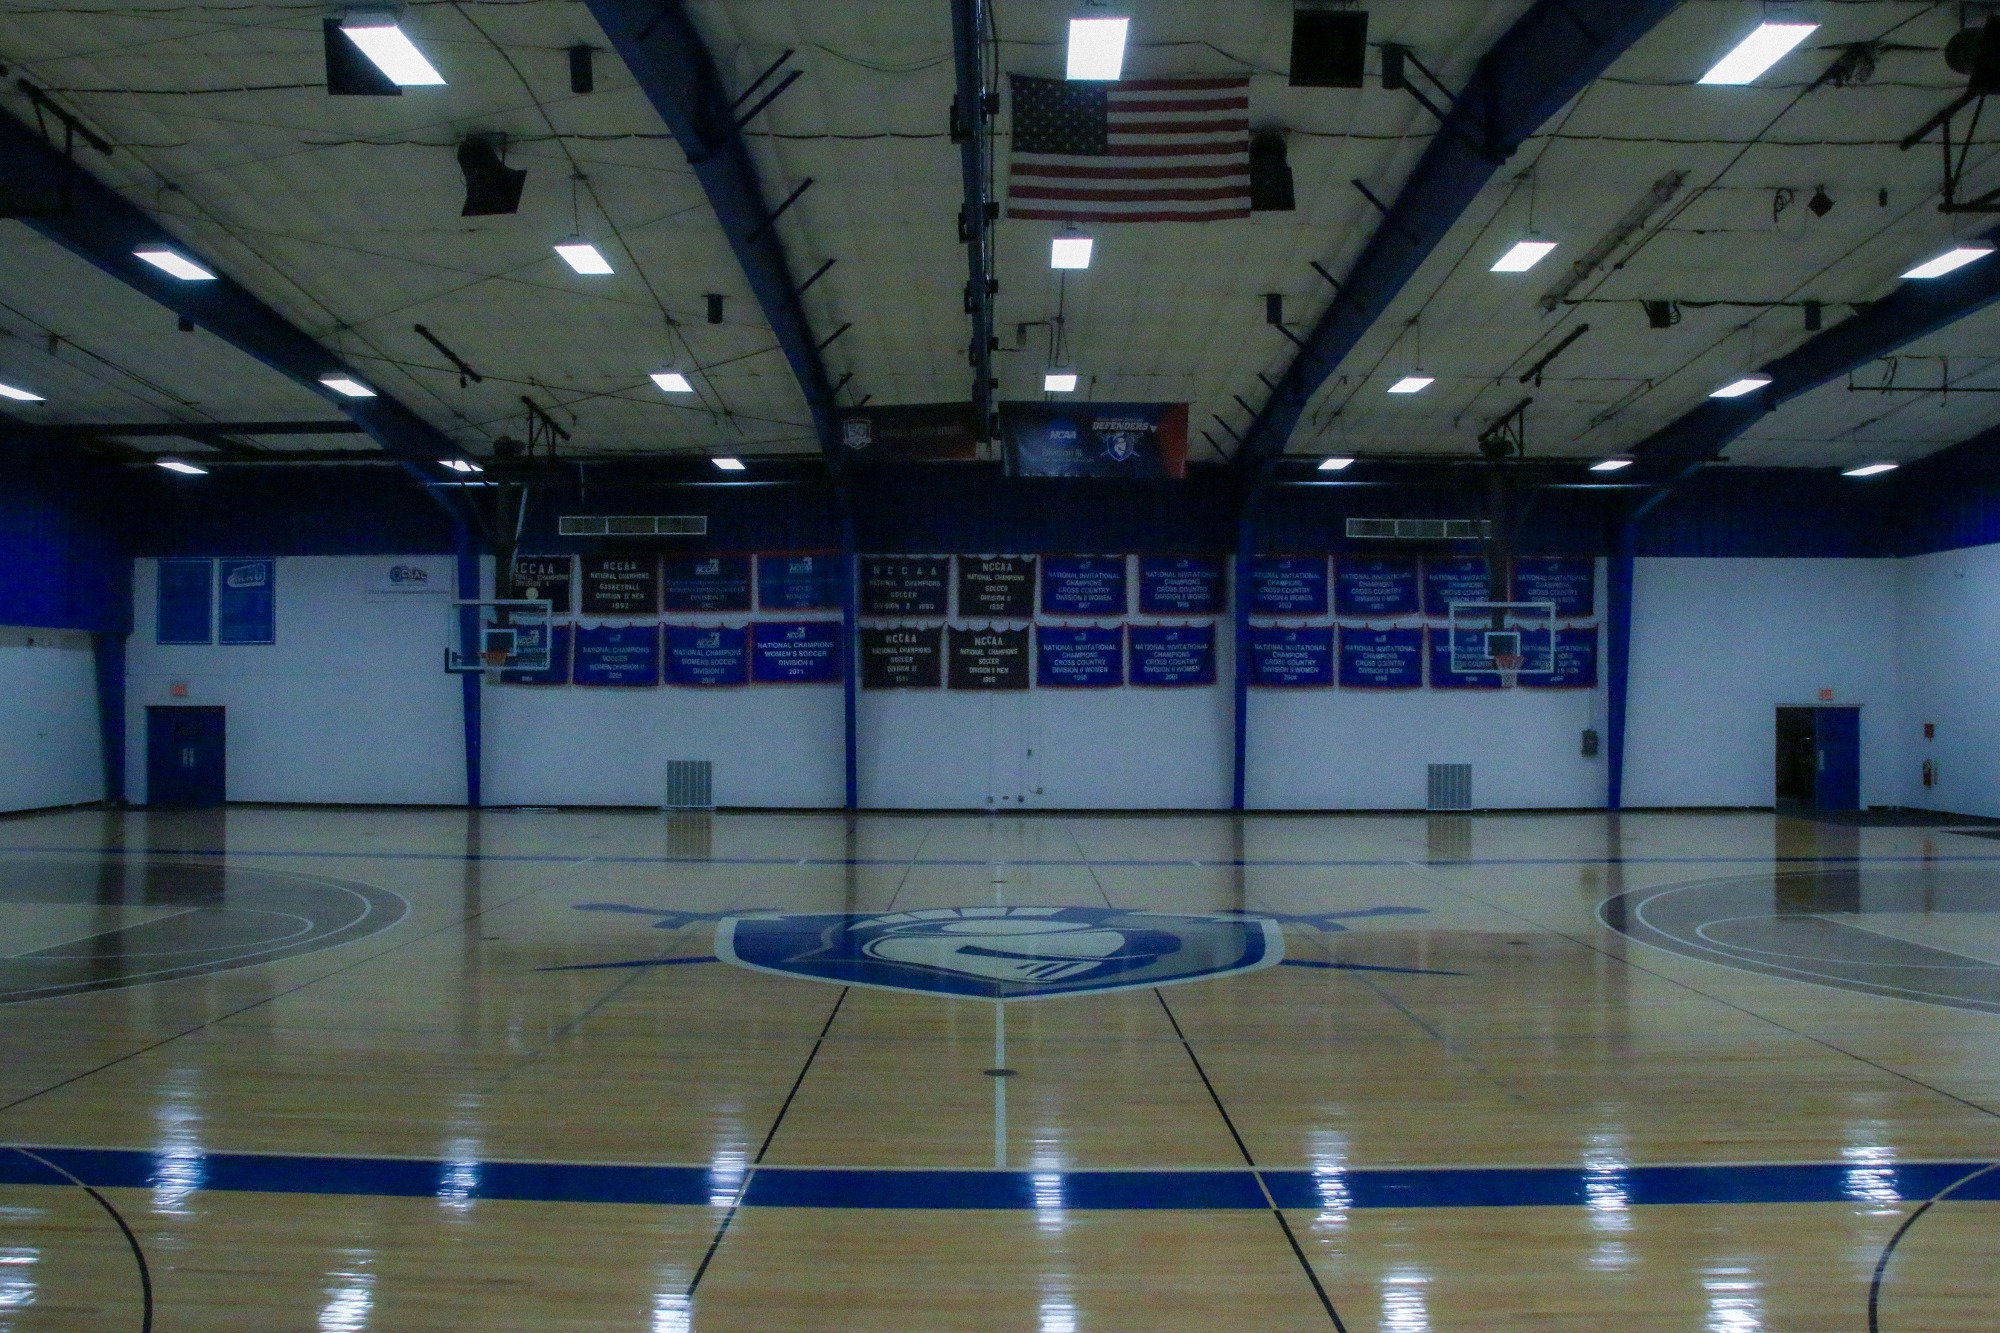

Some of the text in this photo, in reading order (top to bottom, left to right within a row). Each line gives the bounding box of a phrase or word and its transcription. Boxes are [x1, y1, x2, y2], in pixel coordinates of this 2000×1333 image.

[1092, 421, 1149, 431] DEFENDERS
[1050, 430, 1077, 440] NCAA
[603, 562, 637, 571] NCCAA
[982, 562, 1013, 572] NCCAA
[967, 573, 993, 581] NATIONAL
[1047, 571, 1077, 579] NATIONAL
[885, 634, 917, 643] NCCAA
[974, 637, 1003, 646] NCCAA
[757, 641, 834, 649] NATIONAL CHAMPIONS
[1043, 643, 1074, 651] NATIONAL
[1135, 643, 1208, 651] NATIONAL INVITATIONAL
[1345, 644, 1374, 652] NATIONAL
[706, 649, 741, 657] CHAMPIONS
[960, 648, 985, 656] NATIONAL
[1272, 651, 1308, 659] CHAMPIONS
